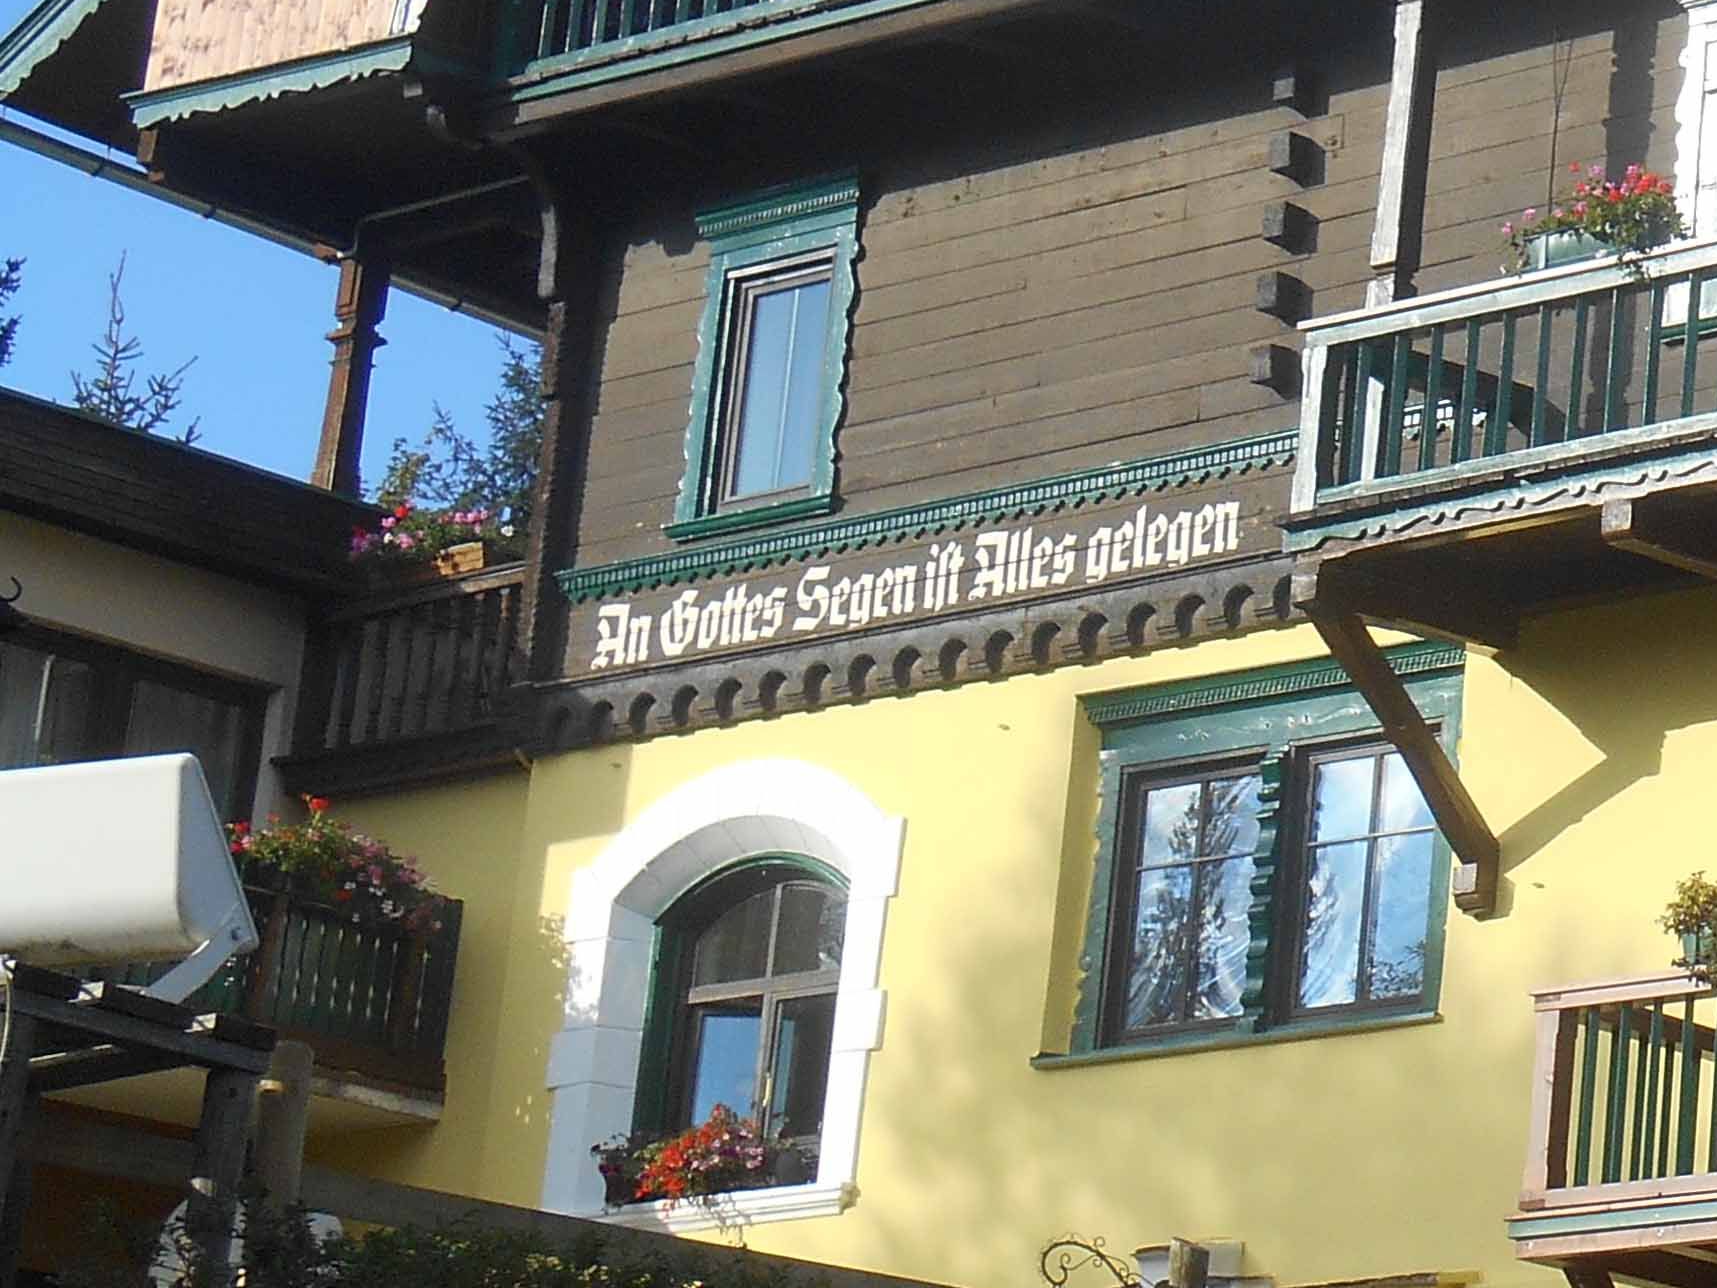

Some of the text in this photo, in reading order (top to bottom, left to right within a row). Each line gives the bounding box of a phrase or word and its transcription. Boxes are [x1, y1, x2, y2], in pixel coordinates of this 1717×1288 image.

[591, 602, 654, 669] An
[660, 581, 787, 654] Gottes
[793, 562, 917, 629] Segen
[968, 529, 1076, 602] Alles
[1084, 500, 1242, 585] gelegen
